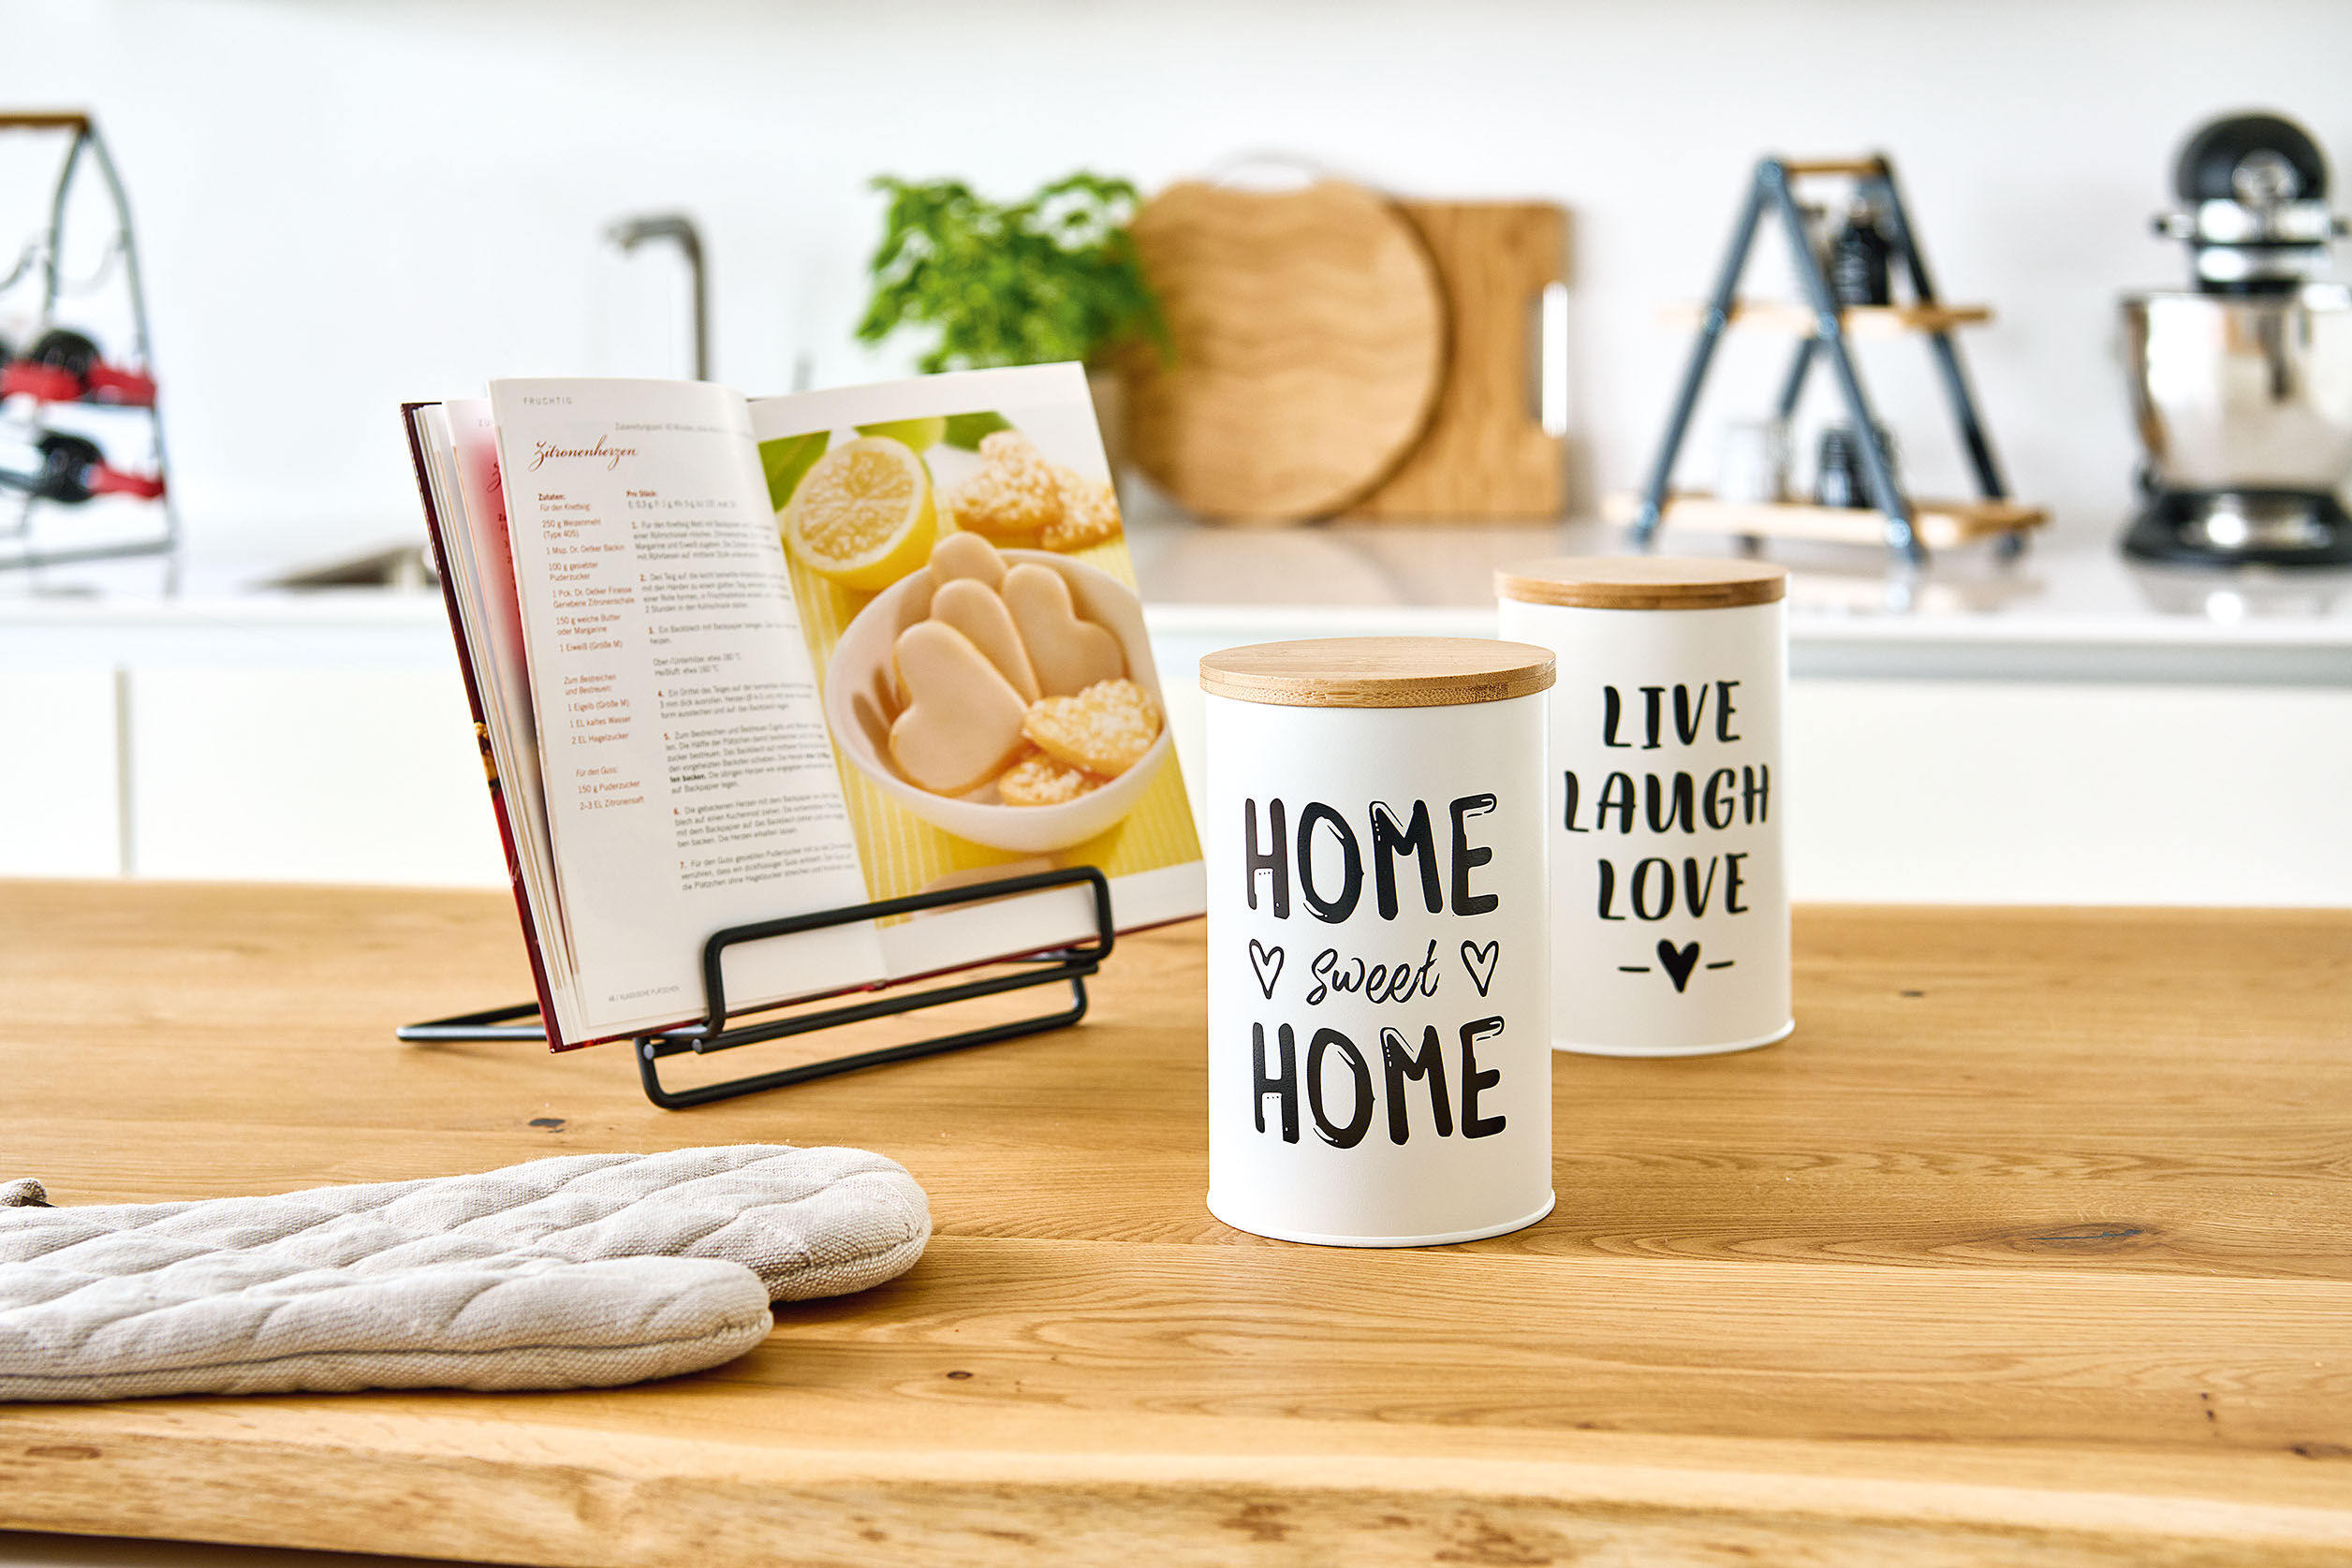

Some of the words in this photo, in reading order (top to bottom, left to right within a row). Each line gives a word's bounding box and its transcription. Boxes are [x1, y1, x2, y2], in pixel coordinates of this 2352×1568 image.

[528, 434, 639, 472] Zitronenherzen
[1603, 681, 1741, 750] LIVE
[1564, 764, 1769, 834] LAUGH
[1244, 793, 1499, 924] HOME
[1597, 852, 1749, 922] LOVE
[1252, 1016, 1507, 1150] HOME
